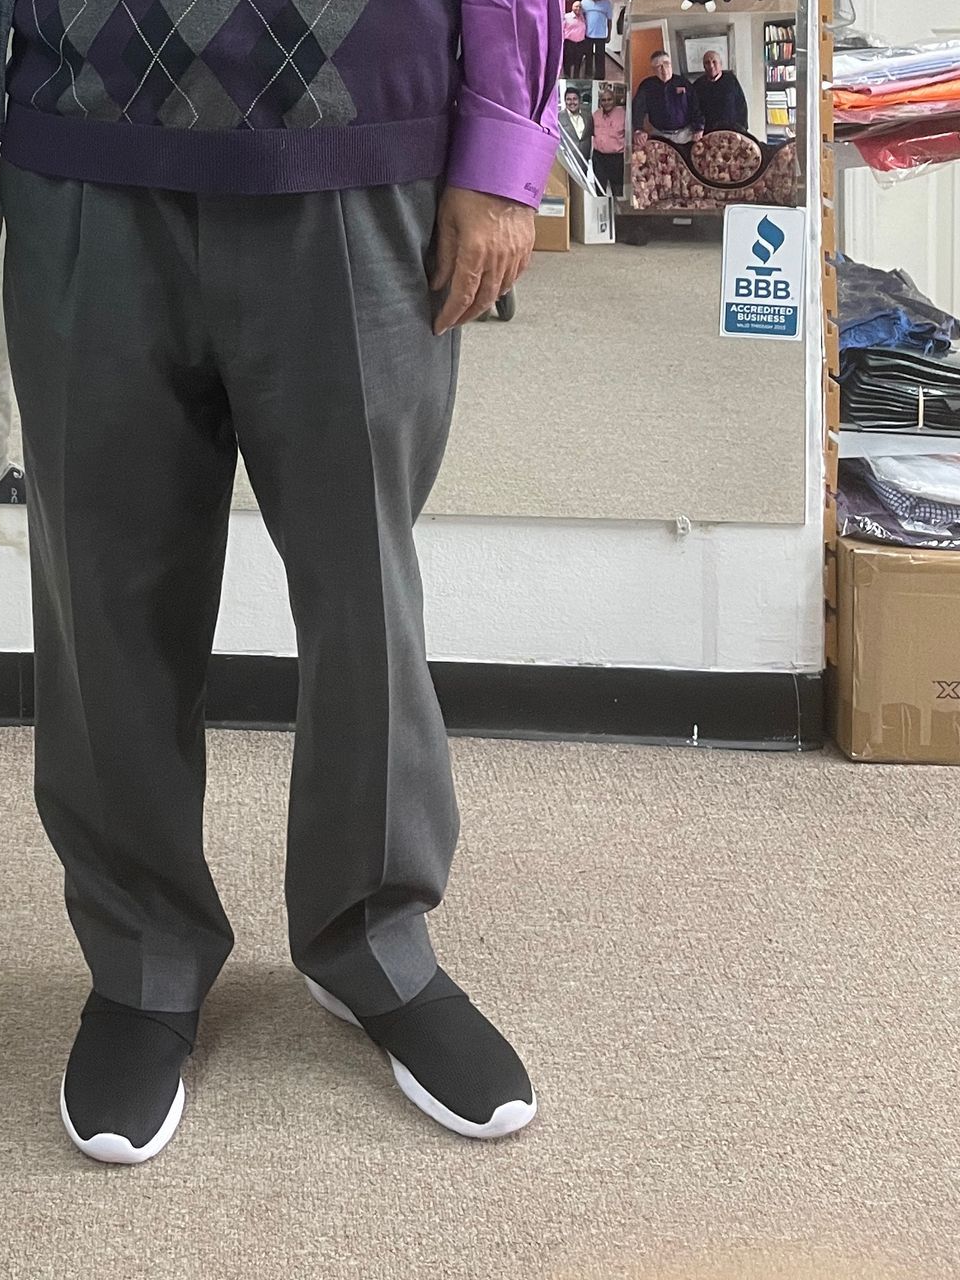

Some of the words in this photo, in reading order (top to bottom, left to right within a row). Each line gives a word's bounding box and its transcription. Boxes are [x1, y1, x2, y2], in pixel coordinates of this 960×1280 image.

[735, 277, 791, 300] BBB
[730, 304, 794, 316] ACCREDITED
[737, 312, 786, 323] BUSINESS
